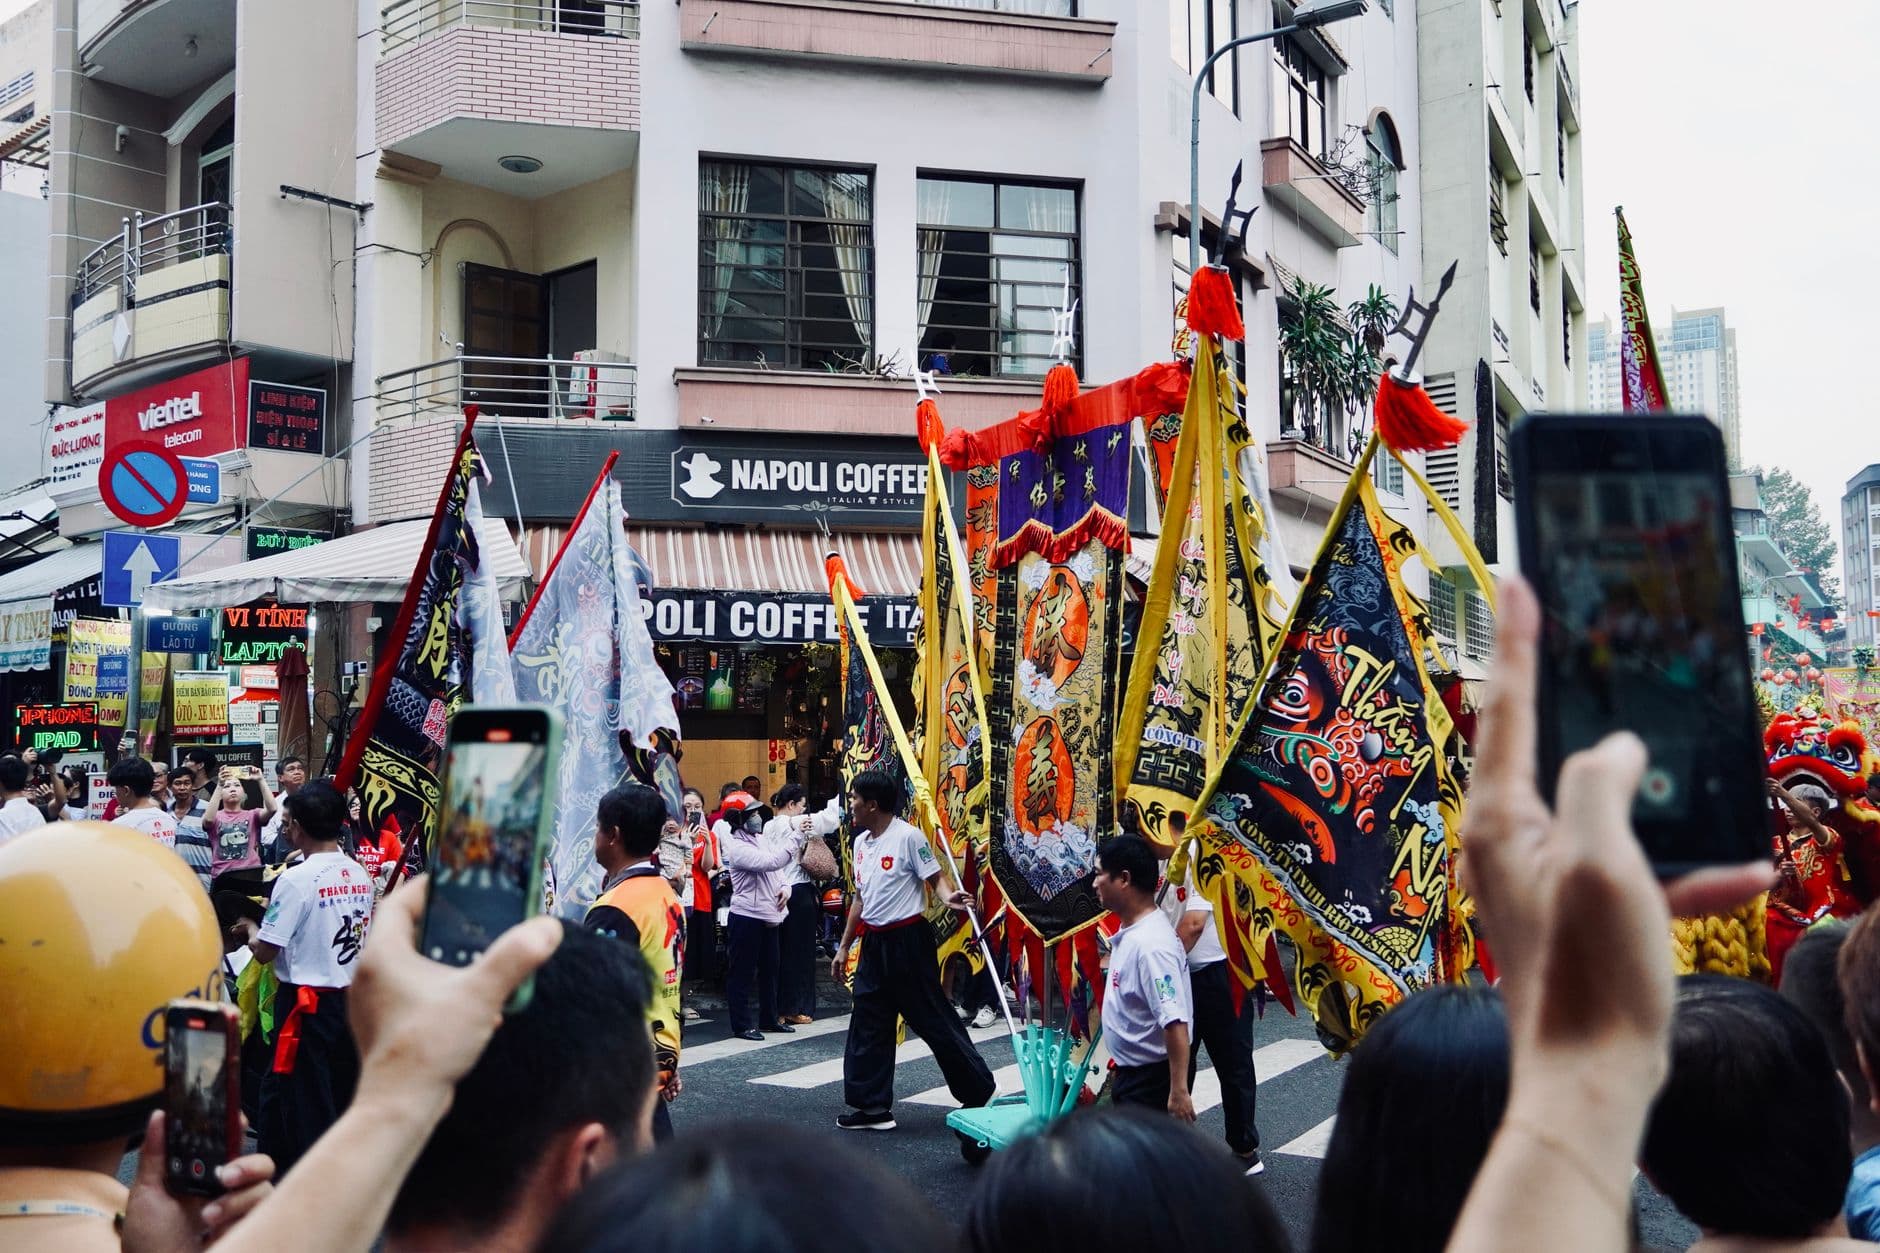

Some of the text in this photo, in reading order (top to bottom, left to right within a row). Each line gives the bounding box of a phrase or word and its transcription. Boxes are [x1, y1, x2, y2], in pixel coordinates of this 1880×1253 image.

[138, 391, 202, 431] viettel
[164, 429, 202, 448] telecom
[282, 434, 290, 447] &
[732, 459, 930, 496] NAPOLI COFFEE
[827, 496, 915, 505] ITALIA STYLE
[52, 608, 78, 629] ALON
[226, 603, 309, 628] VI TÍNH
[640, 599, 716, 636] POLI
[162, 619, 199, 632] ĐƯỜNG
[162, 633, 180, 649] LÃO
[69, 659, 87, 676] RÚT
[68, 682, 92, 699] ĐÓNG
[21, 707, 94, 726] IPHONE
[99, 708, 121, 722] OMO
[198, 704, 208, 721] XE
[209, 698, 226, 721] MÁY
[34, 731, 81, 749] IPAD
[1145, 726, 1203, 754] CÔNG TY
[228, 752, 251, 761] COFFEE
[1240, 817, 1274, 856] CÔNG
[1274, 848, 1293, 870] TY
[1350, 925, 1405, 970] DESIGN
